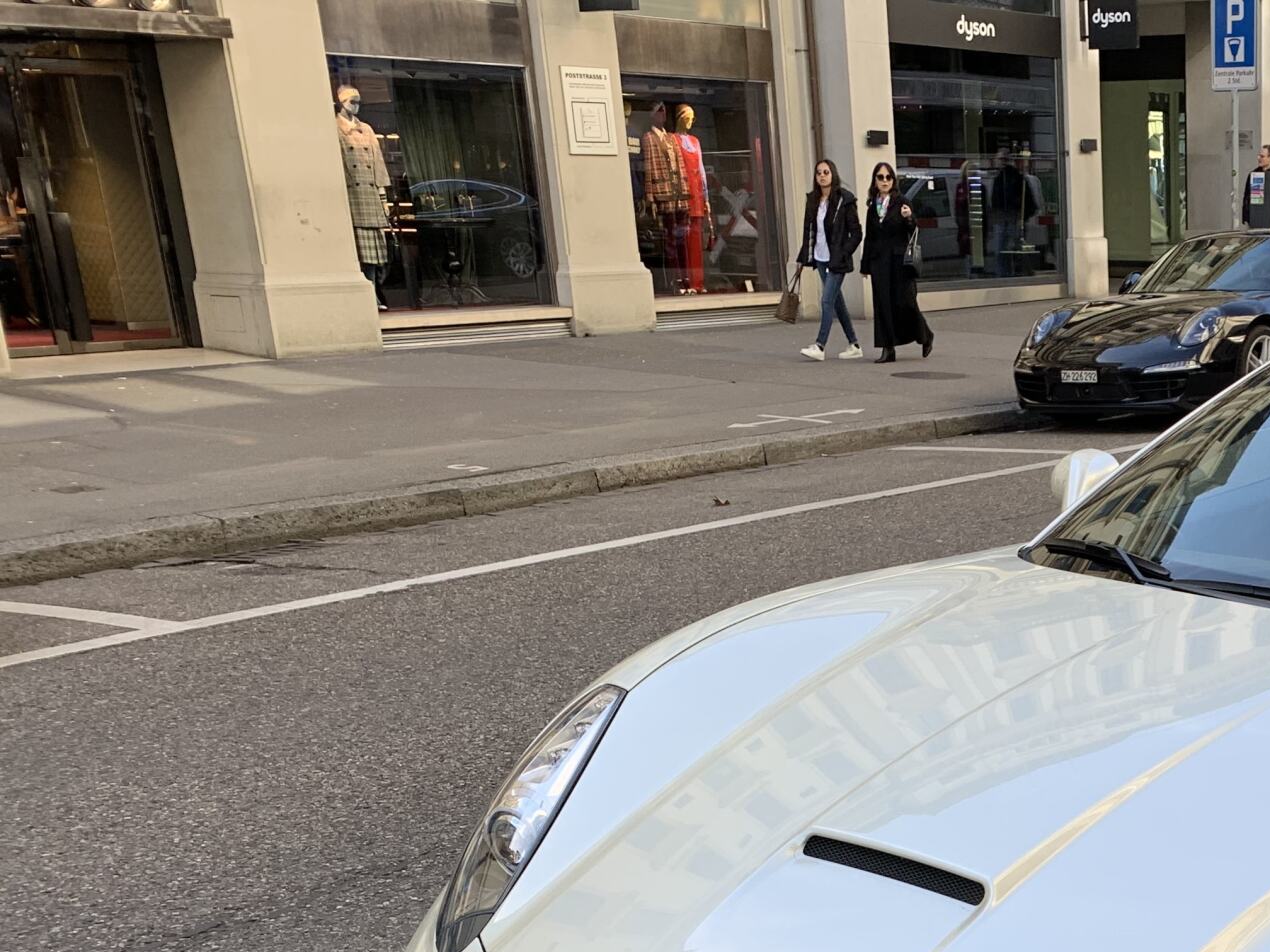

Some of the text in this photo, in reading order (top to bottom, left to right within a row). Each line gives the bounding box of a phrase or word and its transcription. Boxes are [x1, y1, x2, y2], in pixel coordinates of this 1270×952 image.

[956, 14, 996, 41] dyson
[1092, 8, 1131, 28] dyson
[565, 72, 602, 80] POSTSTRASSE
